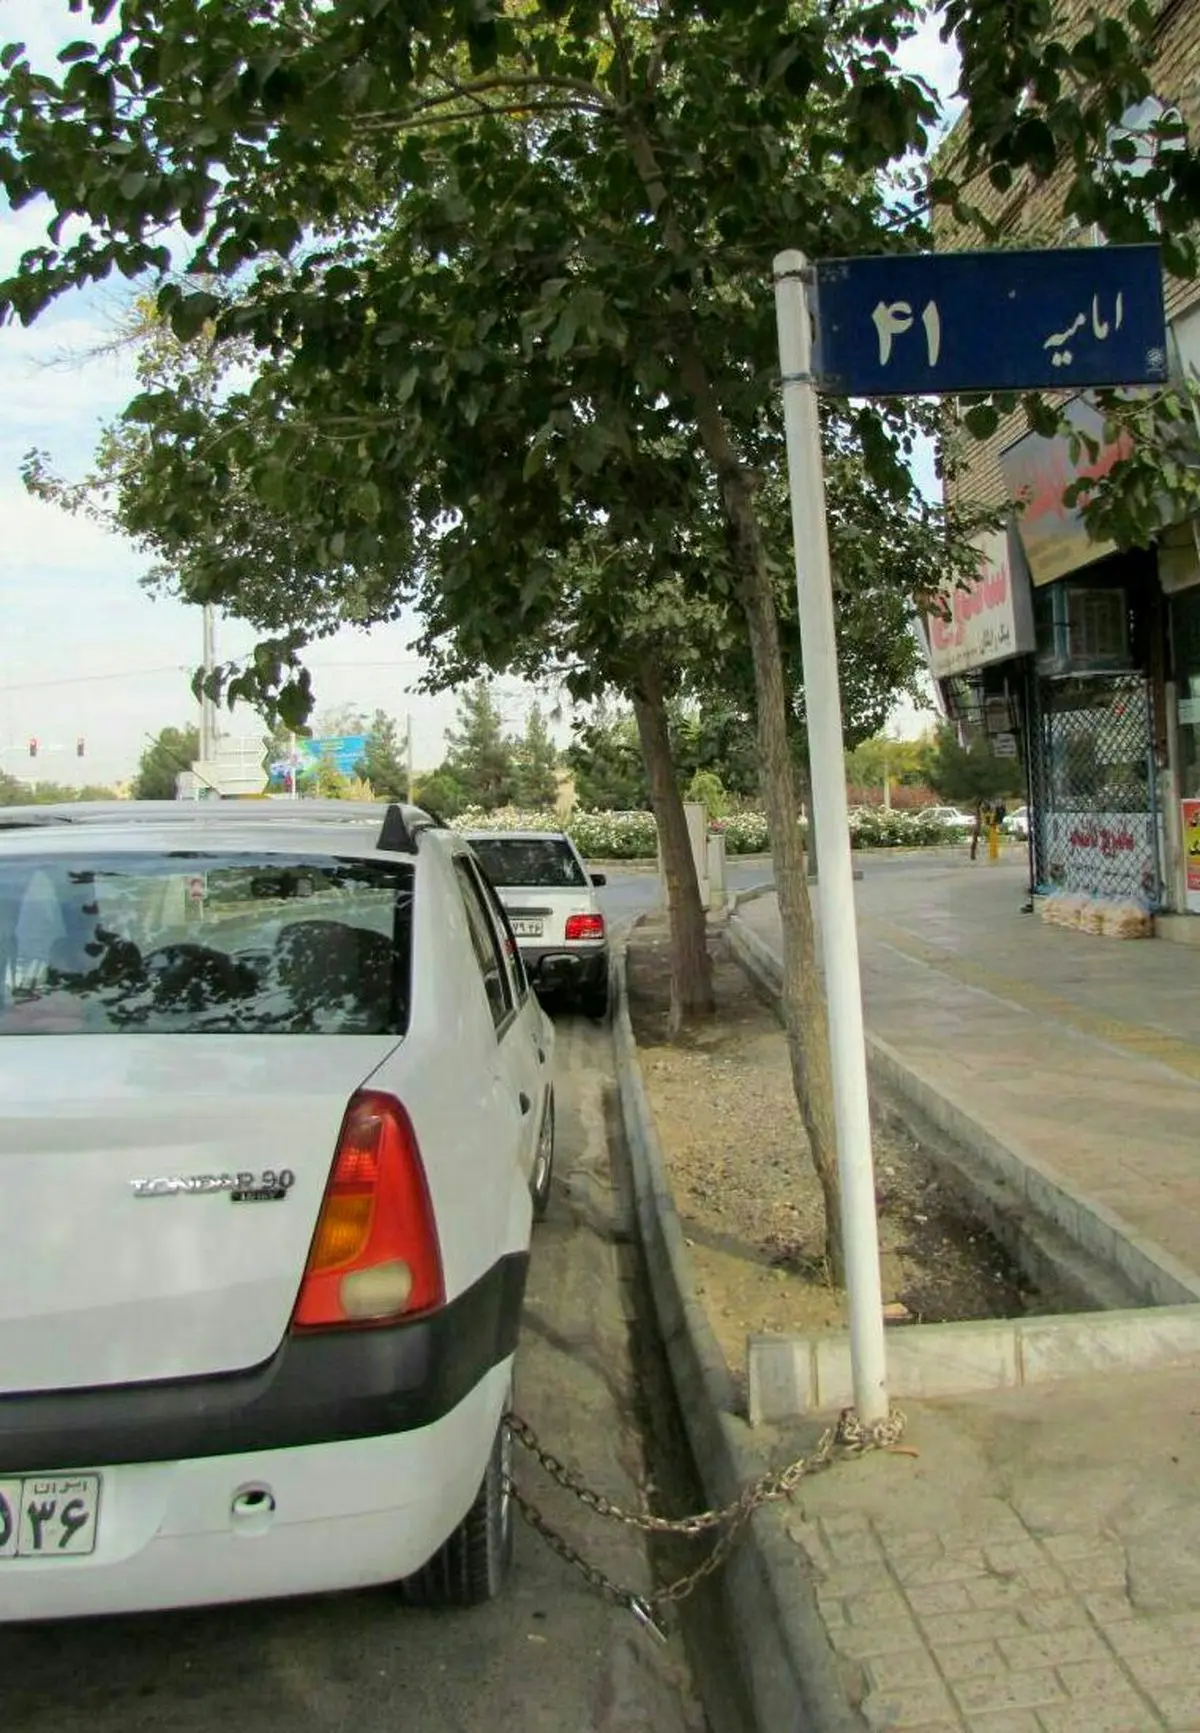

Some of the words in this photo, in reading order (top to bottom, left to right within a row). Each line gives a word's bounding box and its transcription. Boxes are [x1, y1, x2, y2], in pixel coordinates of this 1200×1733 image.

[871, 300, 941, 367] ۴۱
[261, 1168, 296, 1190] 90
[27, 1498, 90, 1550] ۳۶
